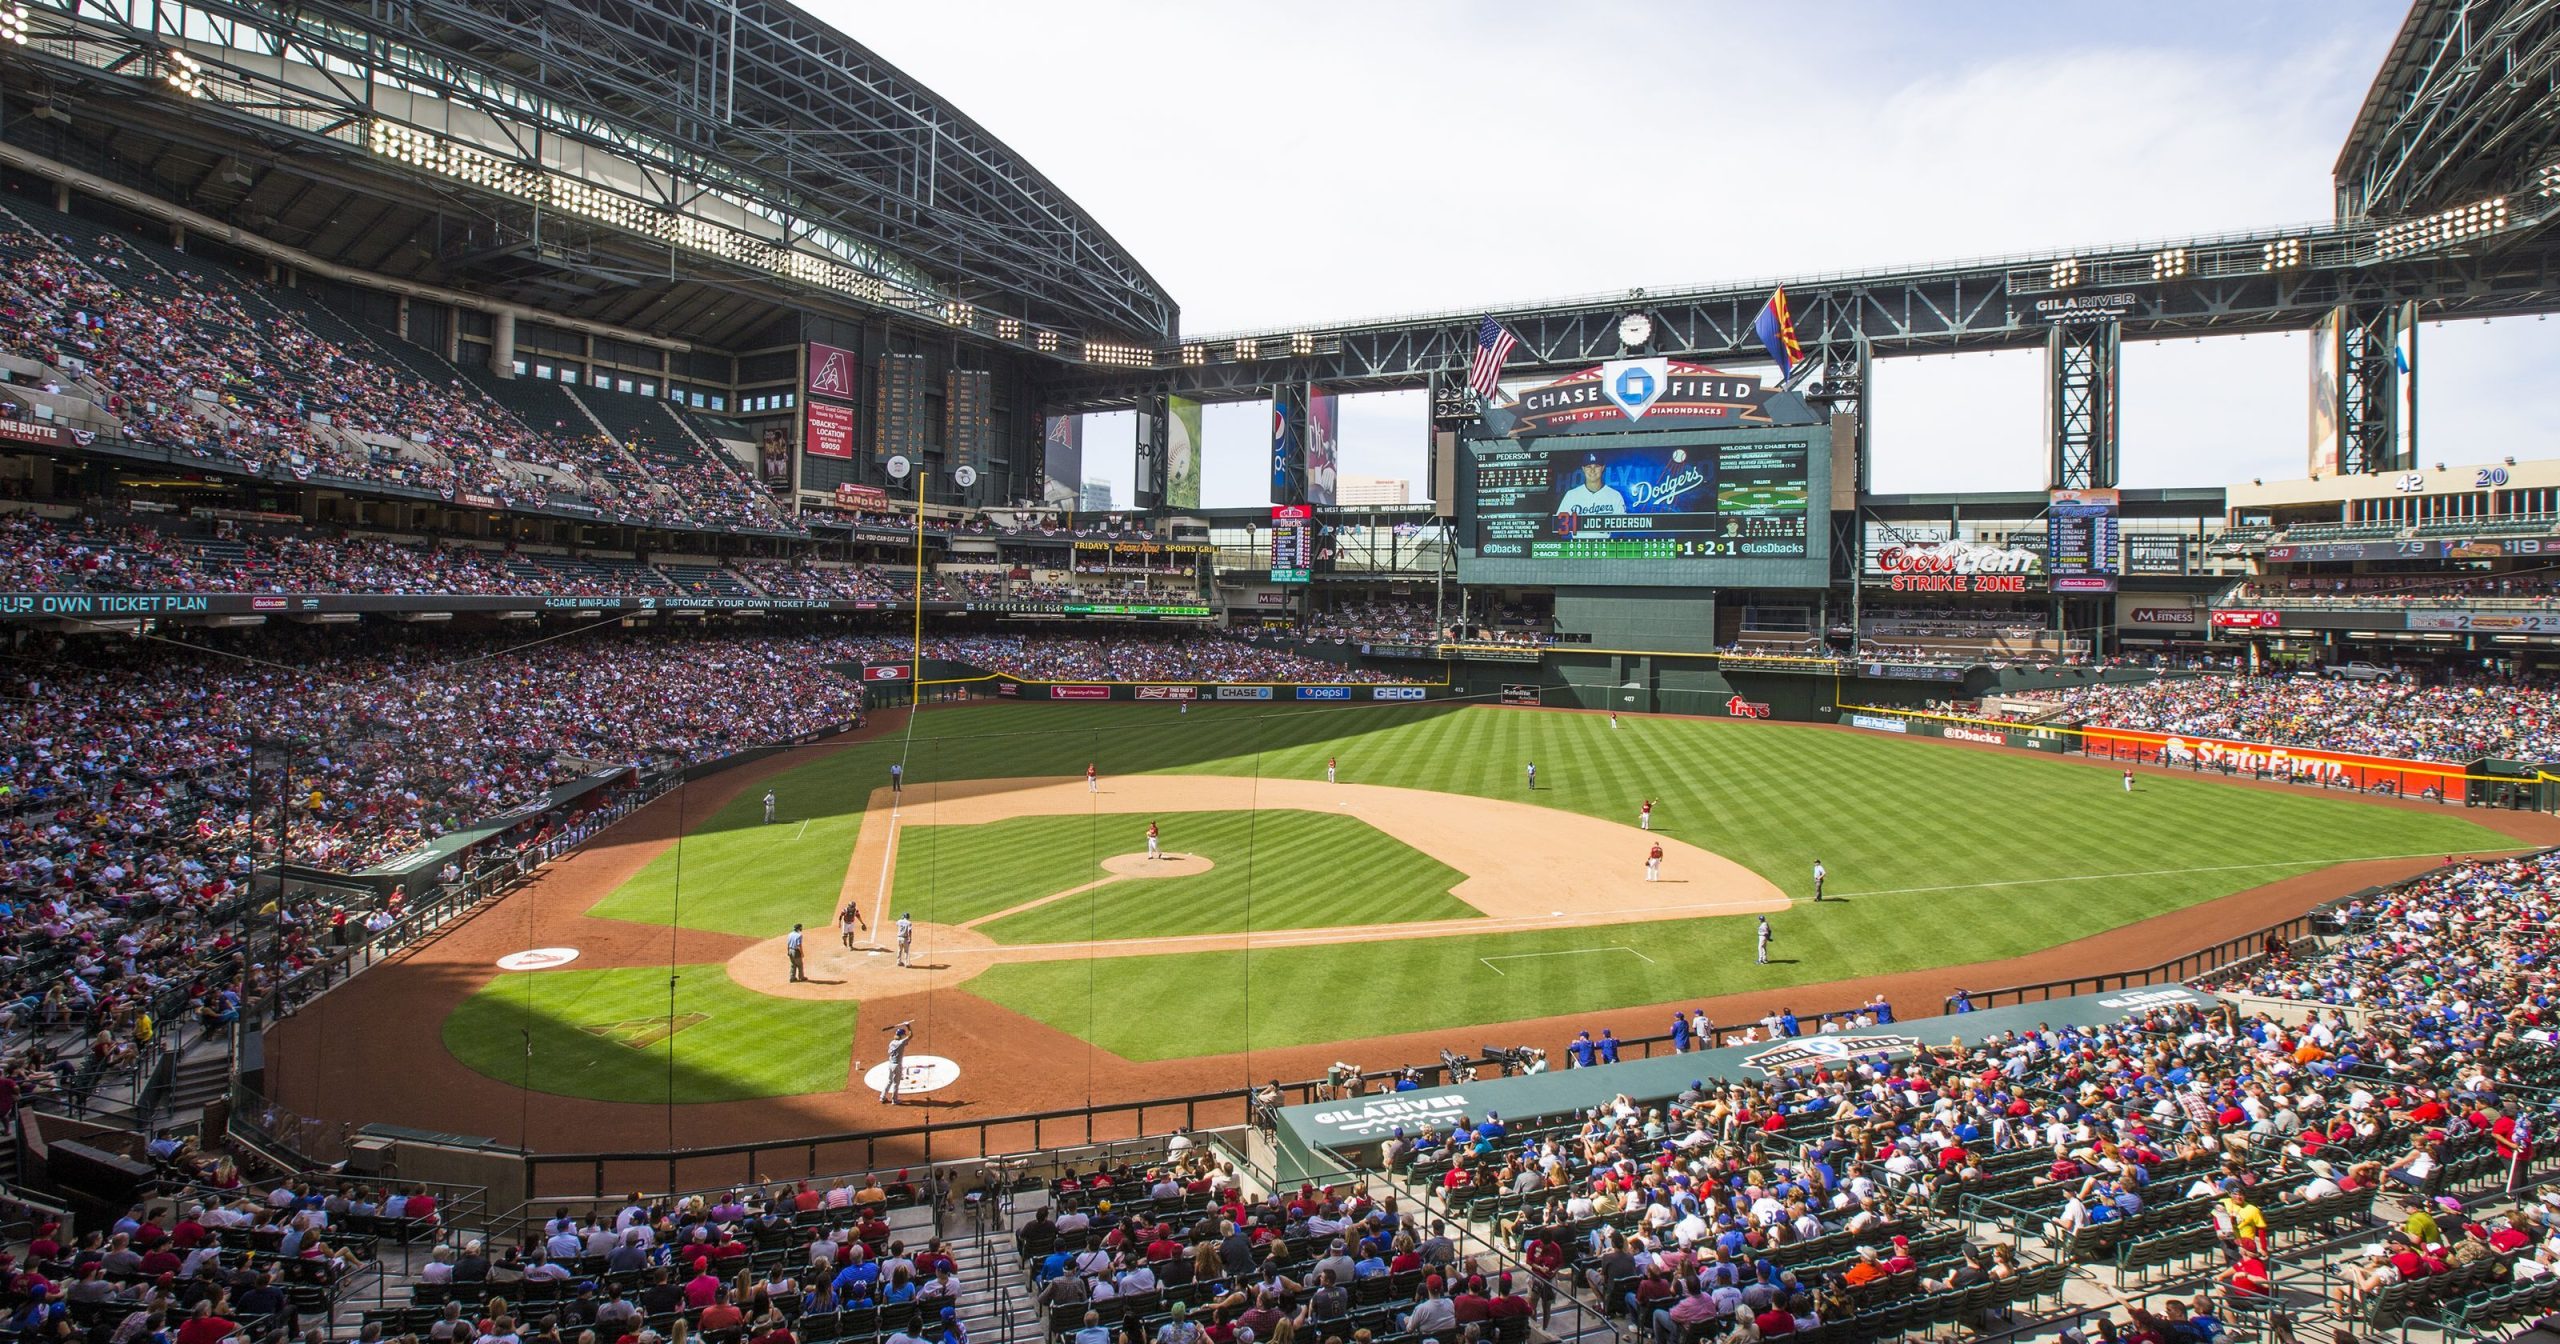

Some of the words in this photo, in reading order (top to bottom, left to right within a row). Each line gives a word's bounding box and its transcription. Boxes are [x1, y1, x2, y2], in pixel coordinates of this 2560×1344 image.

[2054, 315, 2117, 324] CASINOS
[1527, 387, 1598, 410] CHASE
[1673, 382, 1751, 398] FIELD
[1551, 413, 1577, 423] HOME
[1651, 407, 1721, 415] DIAMONDBACKS
[19, 422, 57, 438] BUTTE
[816, 428, 845, 438] LOCATION
[3, 431, 40, 442] CASINO
[821, 442, 840, 450] 69050
[205, 475, 223, 483] Club
[2396, 473, 2423, 492] 42
[2475, 467, 2508, 488] 20
[1631, 466, 1703, 508] Dodgers
[839, 494, 888, 507] SANDLOT
[1571, 502, 1614, 514] Dodgers
[1280, 519, 1302, 527] Dbacks
[1558, 512, 1578, 535] 31
[1584, 518, 1601, 529] JOC
[1604, 517, 1653, 529] PEDERSON
[1075, 542, 1109, 550] FRIDAY'S
[1165, 544, 1197, 552] SPORTS
[1199, 545, 1221, 553] GRILL
[1684, 541, 1694, 555] 1
[1705, 541, 1716, 555] 2
[1726, 541, 1736, 555] 1
[1741, 543, 1804, 553] @LosDbacks
[2132, 537, 2178, 547] CLOTHING
[2396, 542, 2424, 552] 79
[2505, 540, 2541, 554] $19
[1484, 544, 1522, 553] @Dbacks
[2132, 548, 2178, 560] OPTIONAL
[2269, 549, 2289, 557] 2:47
[1879, 546, 1955, 573] Coors
[1955, 552, 2039, 573] LIGHT
[1891, 575, 1968, 592] STRIKE
[1974, 575, 2026, 592] ZONE
[42, 597, 91, 612] OWN
[98, 596, 160, 611] TICKET
[165, 596, 207, 611] PLAN
[545, 598, 577, 607] 4-GAME
[578, 598, 620, 607] MINI-PLANS
[665, 598, 714, 607] CUSTOMIZE
[717, 599, 745, 608] YOUR
[747, 600, 771, 608] OWN
[773, 600, 804, 608] TICKET
[806, 600, 830, 609] PLAN
[2157, 613, 2193, 621] FITNESS
[2458, 616, 2469, 630] 2
[1222, 688, 1257, 696] CHASE
[1315, 688, 1343, 698] pepsi
[1374, 687, 1425, 699] GEICO
[1726, 695, 1770, 718] fry's
[1944, 727, 2002, 744] @Dbacks
[2027, 740, 2040, 748] 376
[2197, 741, 2266, 773] State
[2268, 749, 2342, 784] Farm
[1759, 1049, 1809, 1065] CHASE
[1848, 1038, 1900, 1049] FIELD
